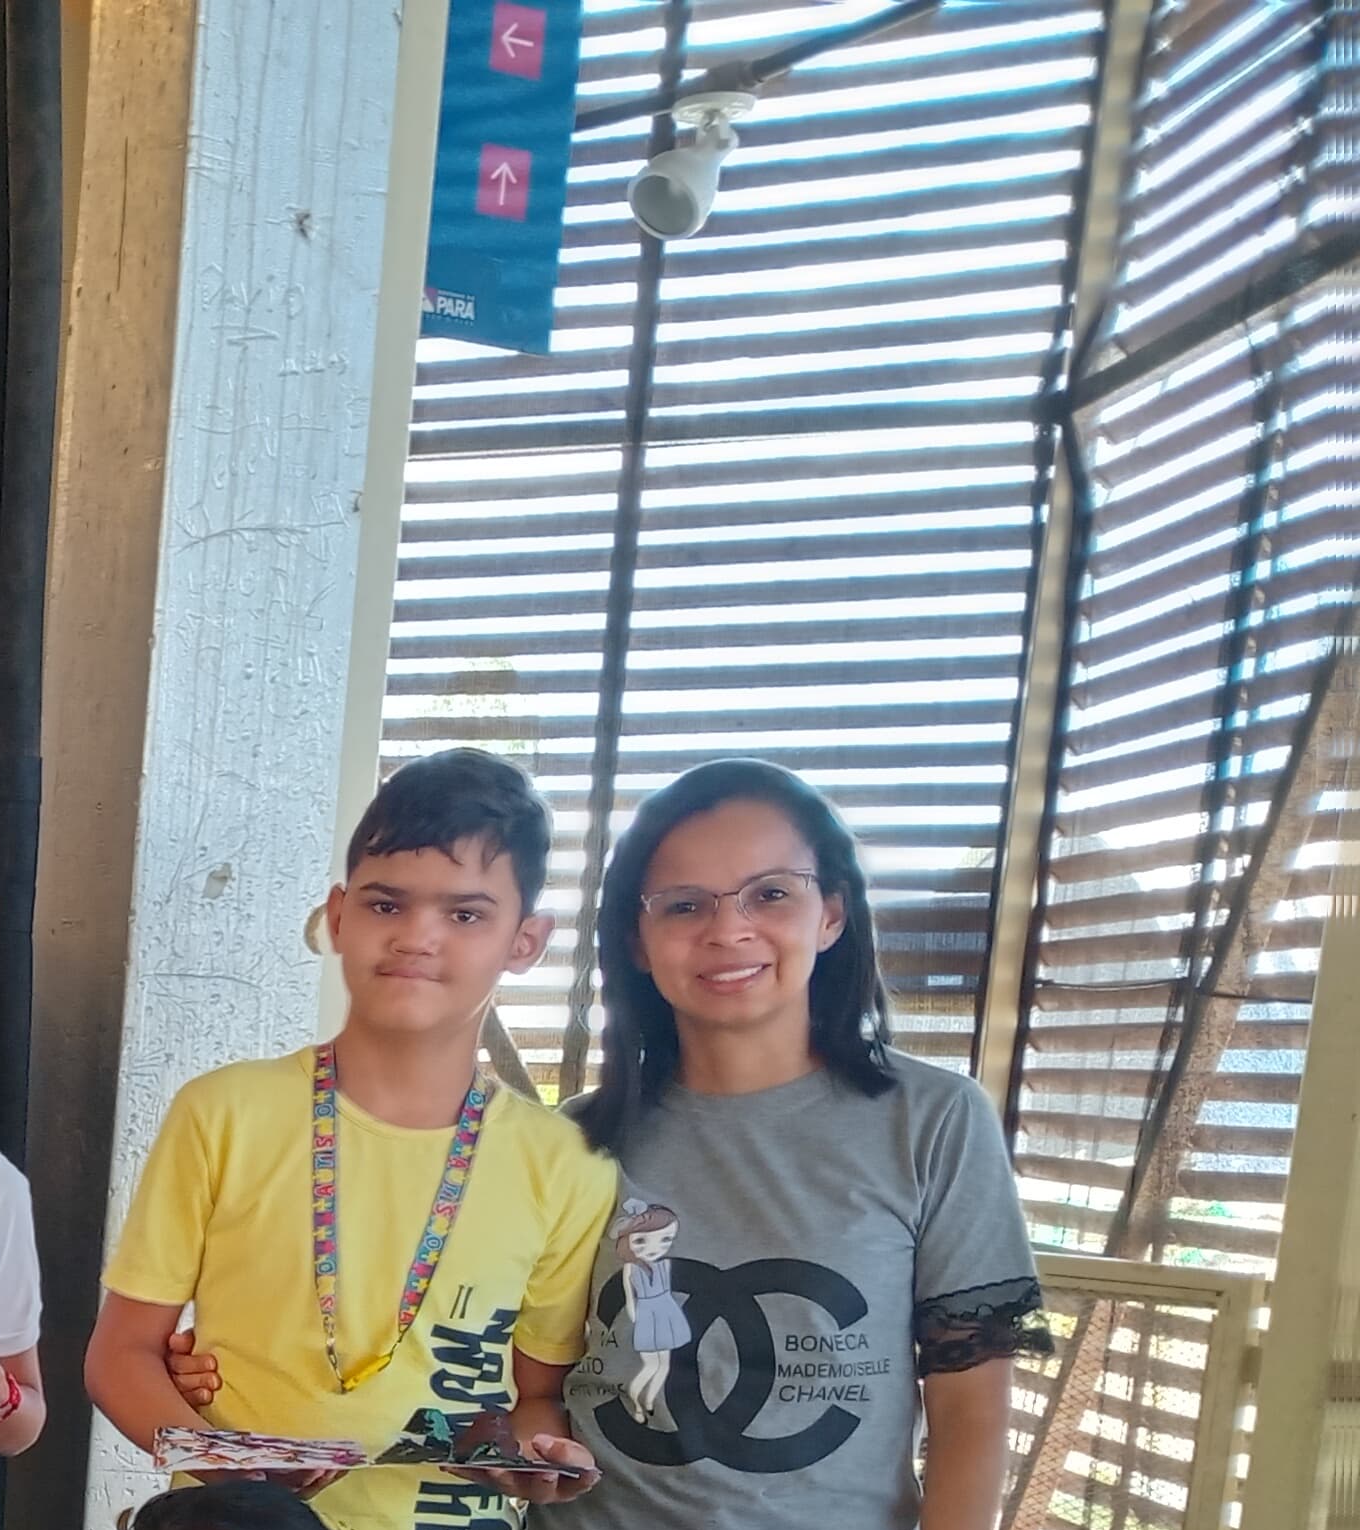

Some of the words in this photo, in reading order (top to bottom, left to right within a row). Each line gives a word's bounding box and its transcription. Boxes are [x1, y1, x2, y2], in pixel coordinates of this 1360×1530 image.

[785, 1333, 870, 1353] BONECA
[777, 1358, 890, 1379] MADEMOISELLE
[778, 1383, 871, 1403] CHANEL
